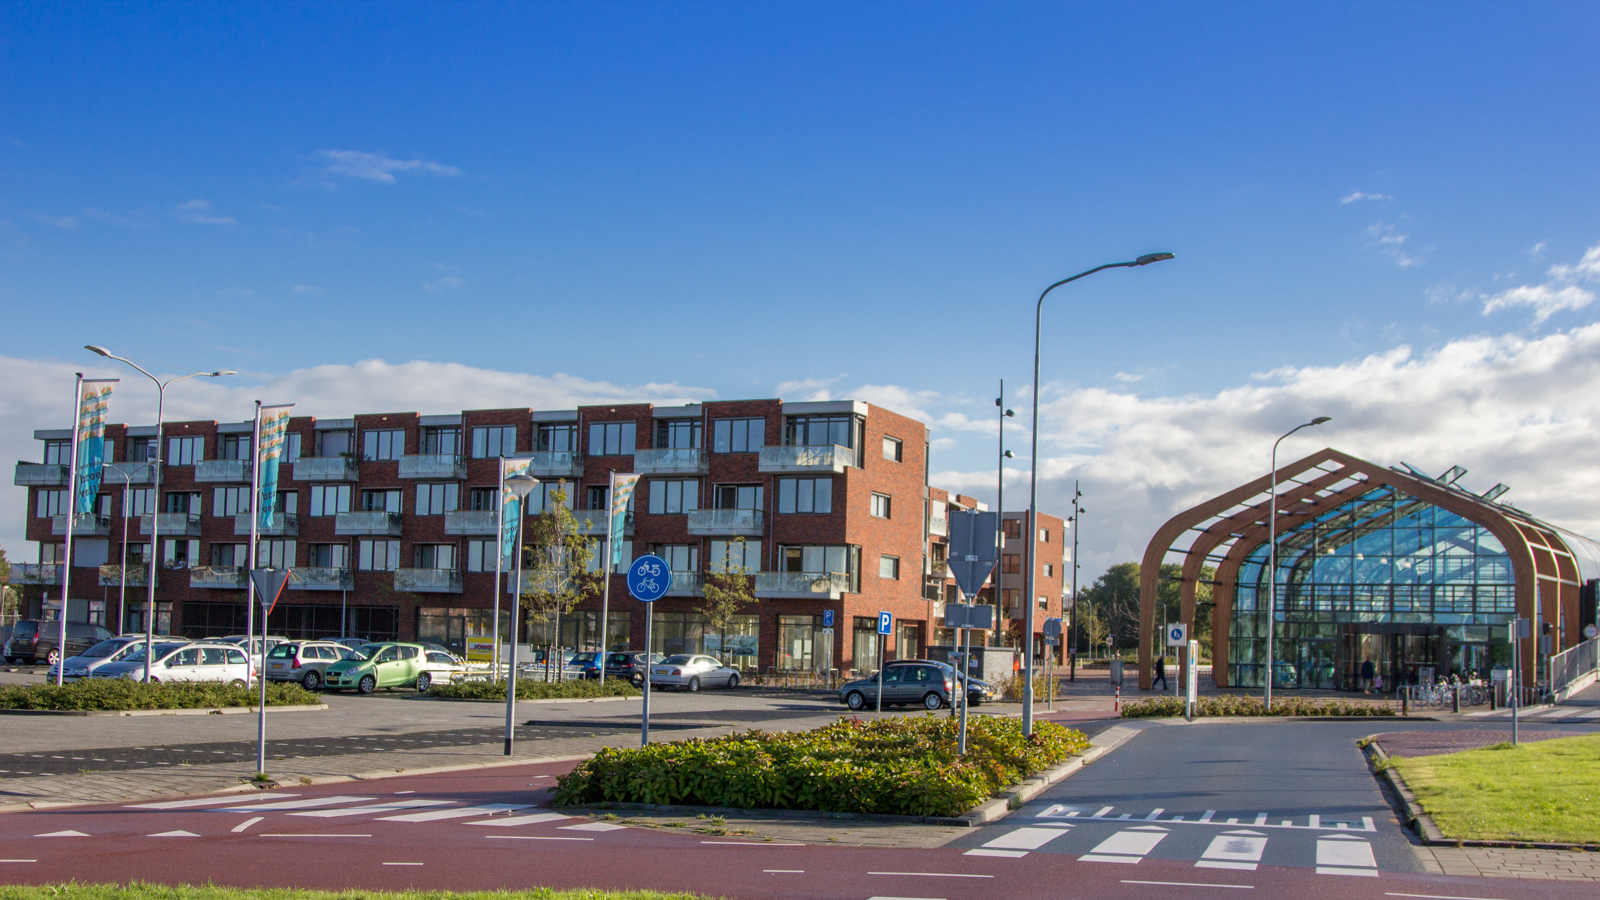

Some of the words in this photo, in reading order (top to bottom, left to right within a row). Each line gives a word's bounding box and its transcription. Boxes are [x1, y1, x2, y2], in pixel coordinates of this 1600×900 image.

[80, 470, 102, 483] broe
[79, 484, 99, 498] veil
[826, 611, 832, 620] P
[881, 613, 890, 632] P
